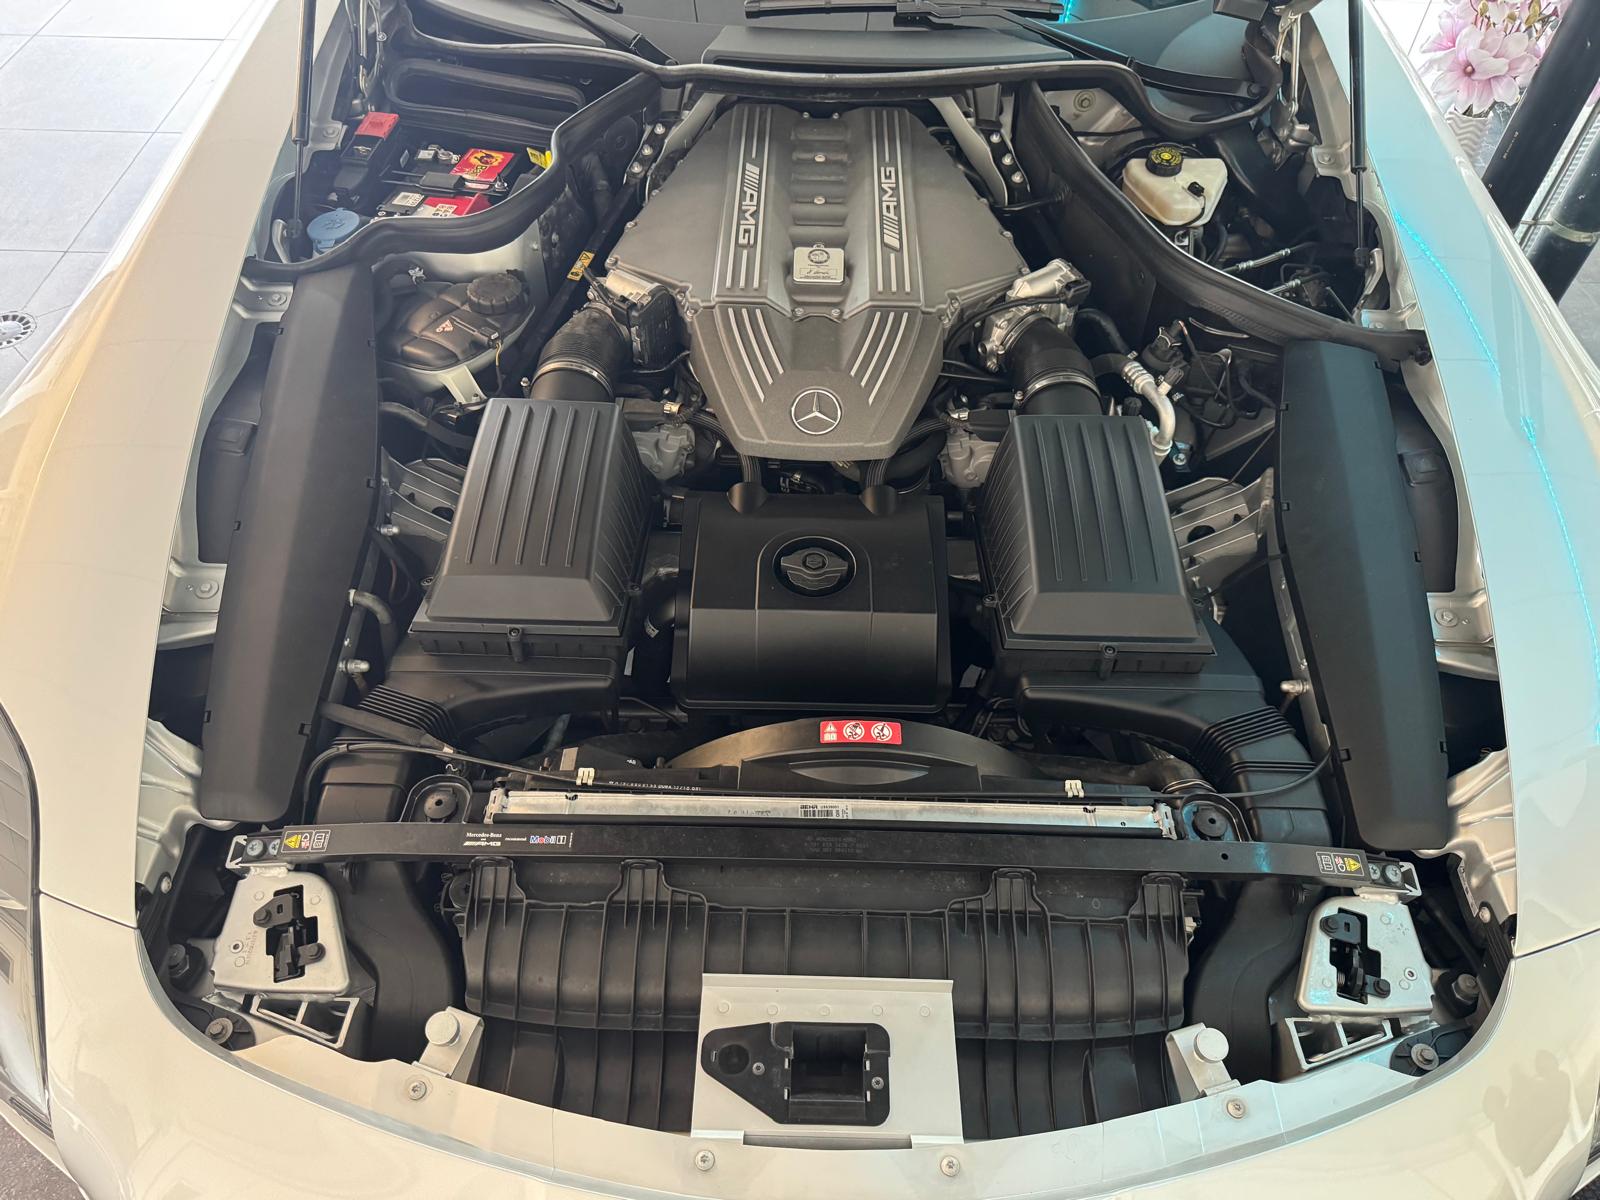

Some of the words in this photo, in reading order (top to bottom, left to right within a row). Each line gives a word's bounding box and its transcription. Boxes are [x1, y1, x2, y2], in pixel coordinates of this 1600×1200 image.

[738, 187, 759, 246] AMG
[880, 166, 898, 221] AMG
[529, 835, 557, 844] Mobil
